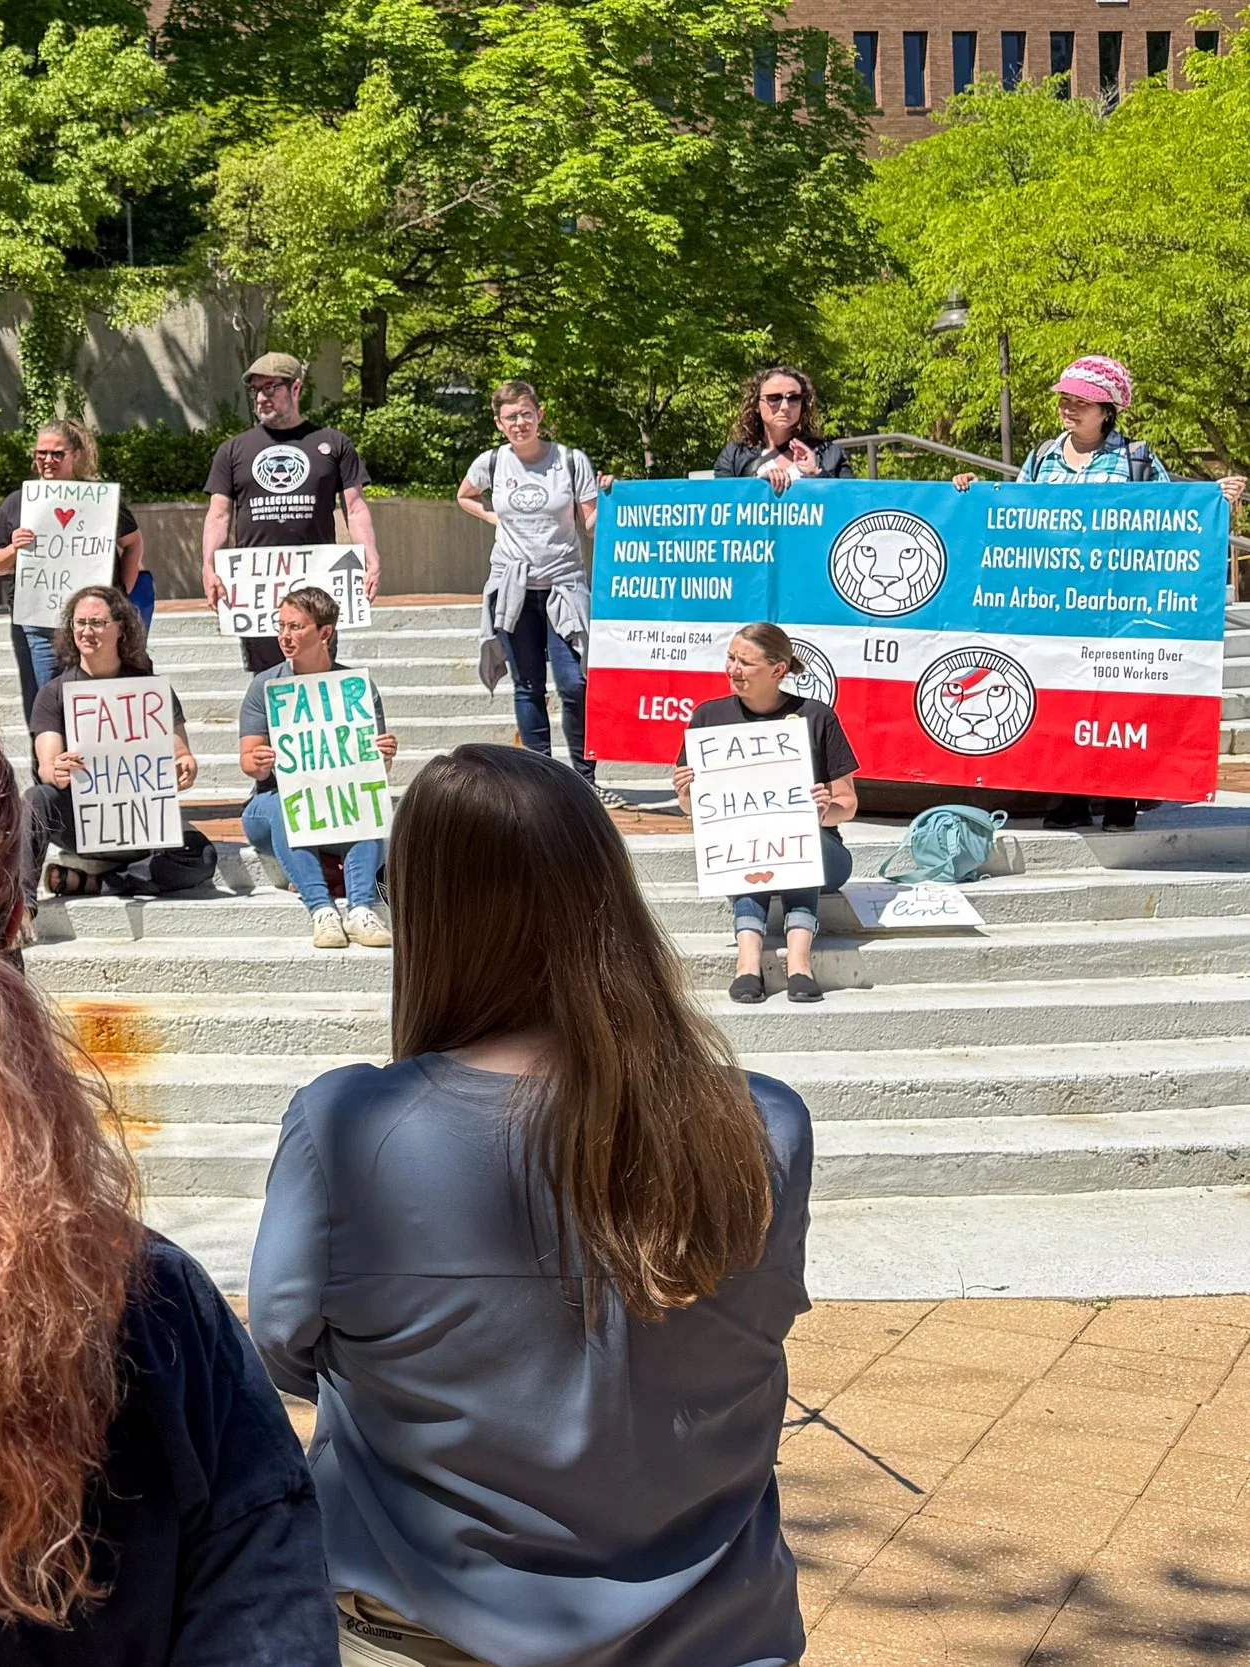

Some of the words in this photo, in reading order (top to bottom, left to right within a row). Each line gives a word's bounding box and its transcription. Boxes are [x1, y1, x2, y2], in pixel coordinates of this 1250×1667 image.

[26, 484, 109, 504] UMMAP
[616, 503, 708, 527] UNIVERSITY
[711, 503, 732, 526] OF
[736, 502, 824, 526] MICHIGAN
[987, 507, 1087, 533] LECTURERS,
[1091, 508, 1203, 535] LIBRARIANS,
[229, 551, 312, 578] FLINT
[613, 540, 717, 563] NON-TENURE
[721, 539, 776, 563] TRACK
[981, 546, 1085, 573] ARCHIVISTS,
[1089, 549, 1103, 570] &
[1107, 548, 1201, 572] CURATORS
[20, 567, 73, 591] FAIR
[610, 576, 676, 599] FACULTY
[681, 577, 733, 600] UNION
[973, 584, 1005, 607] Ann
[1009, 586, 1060, 612] Arbor,
[1065, 587, 1152, 614] Dearborn,
[1157, 589, 1198, 612] Flint
[627, 630, 659, 643] AFT-MI
[661, 631, 686, 643] Local
[688, 632, 712, 645] 6244
[863, 638, 899, 663] LEO
[650, 648, 687, 661] AFL-CIO
[1081, 646, 1154, 664] Representing
[1157, 648, 1184, 662] Over
[1092, 666, 1120, 679] 1800
[1122, 666, 1169, 681] Workers
[266, 676, 373, 728] FAIR
[638, 695, 694, 722] LECS
[72, 691, 168, 742] FAIR
[1074, 719, 1148, 750] GLAM
[276, 724, 380, 774] SHARE
[698, 733, 801, 768] FAIR
[283, 780, 387, 833] FLINT
[698, 786, 810, 819] SHARE
[79, 795, 176, 847] FLINT
[705, 834, 813, 869] FLINT
